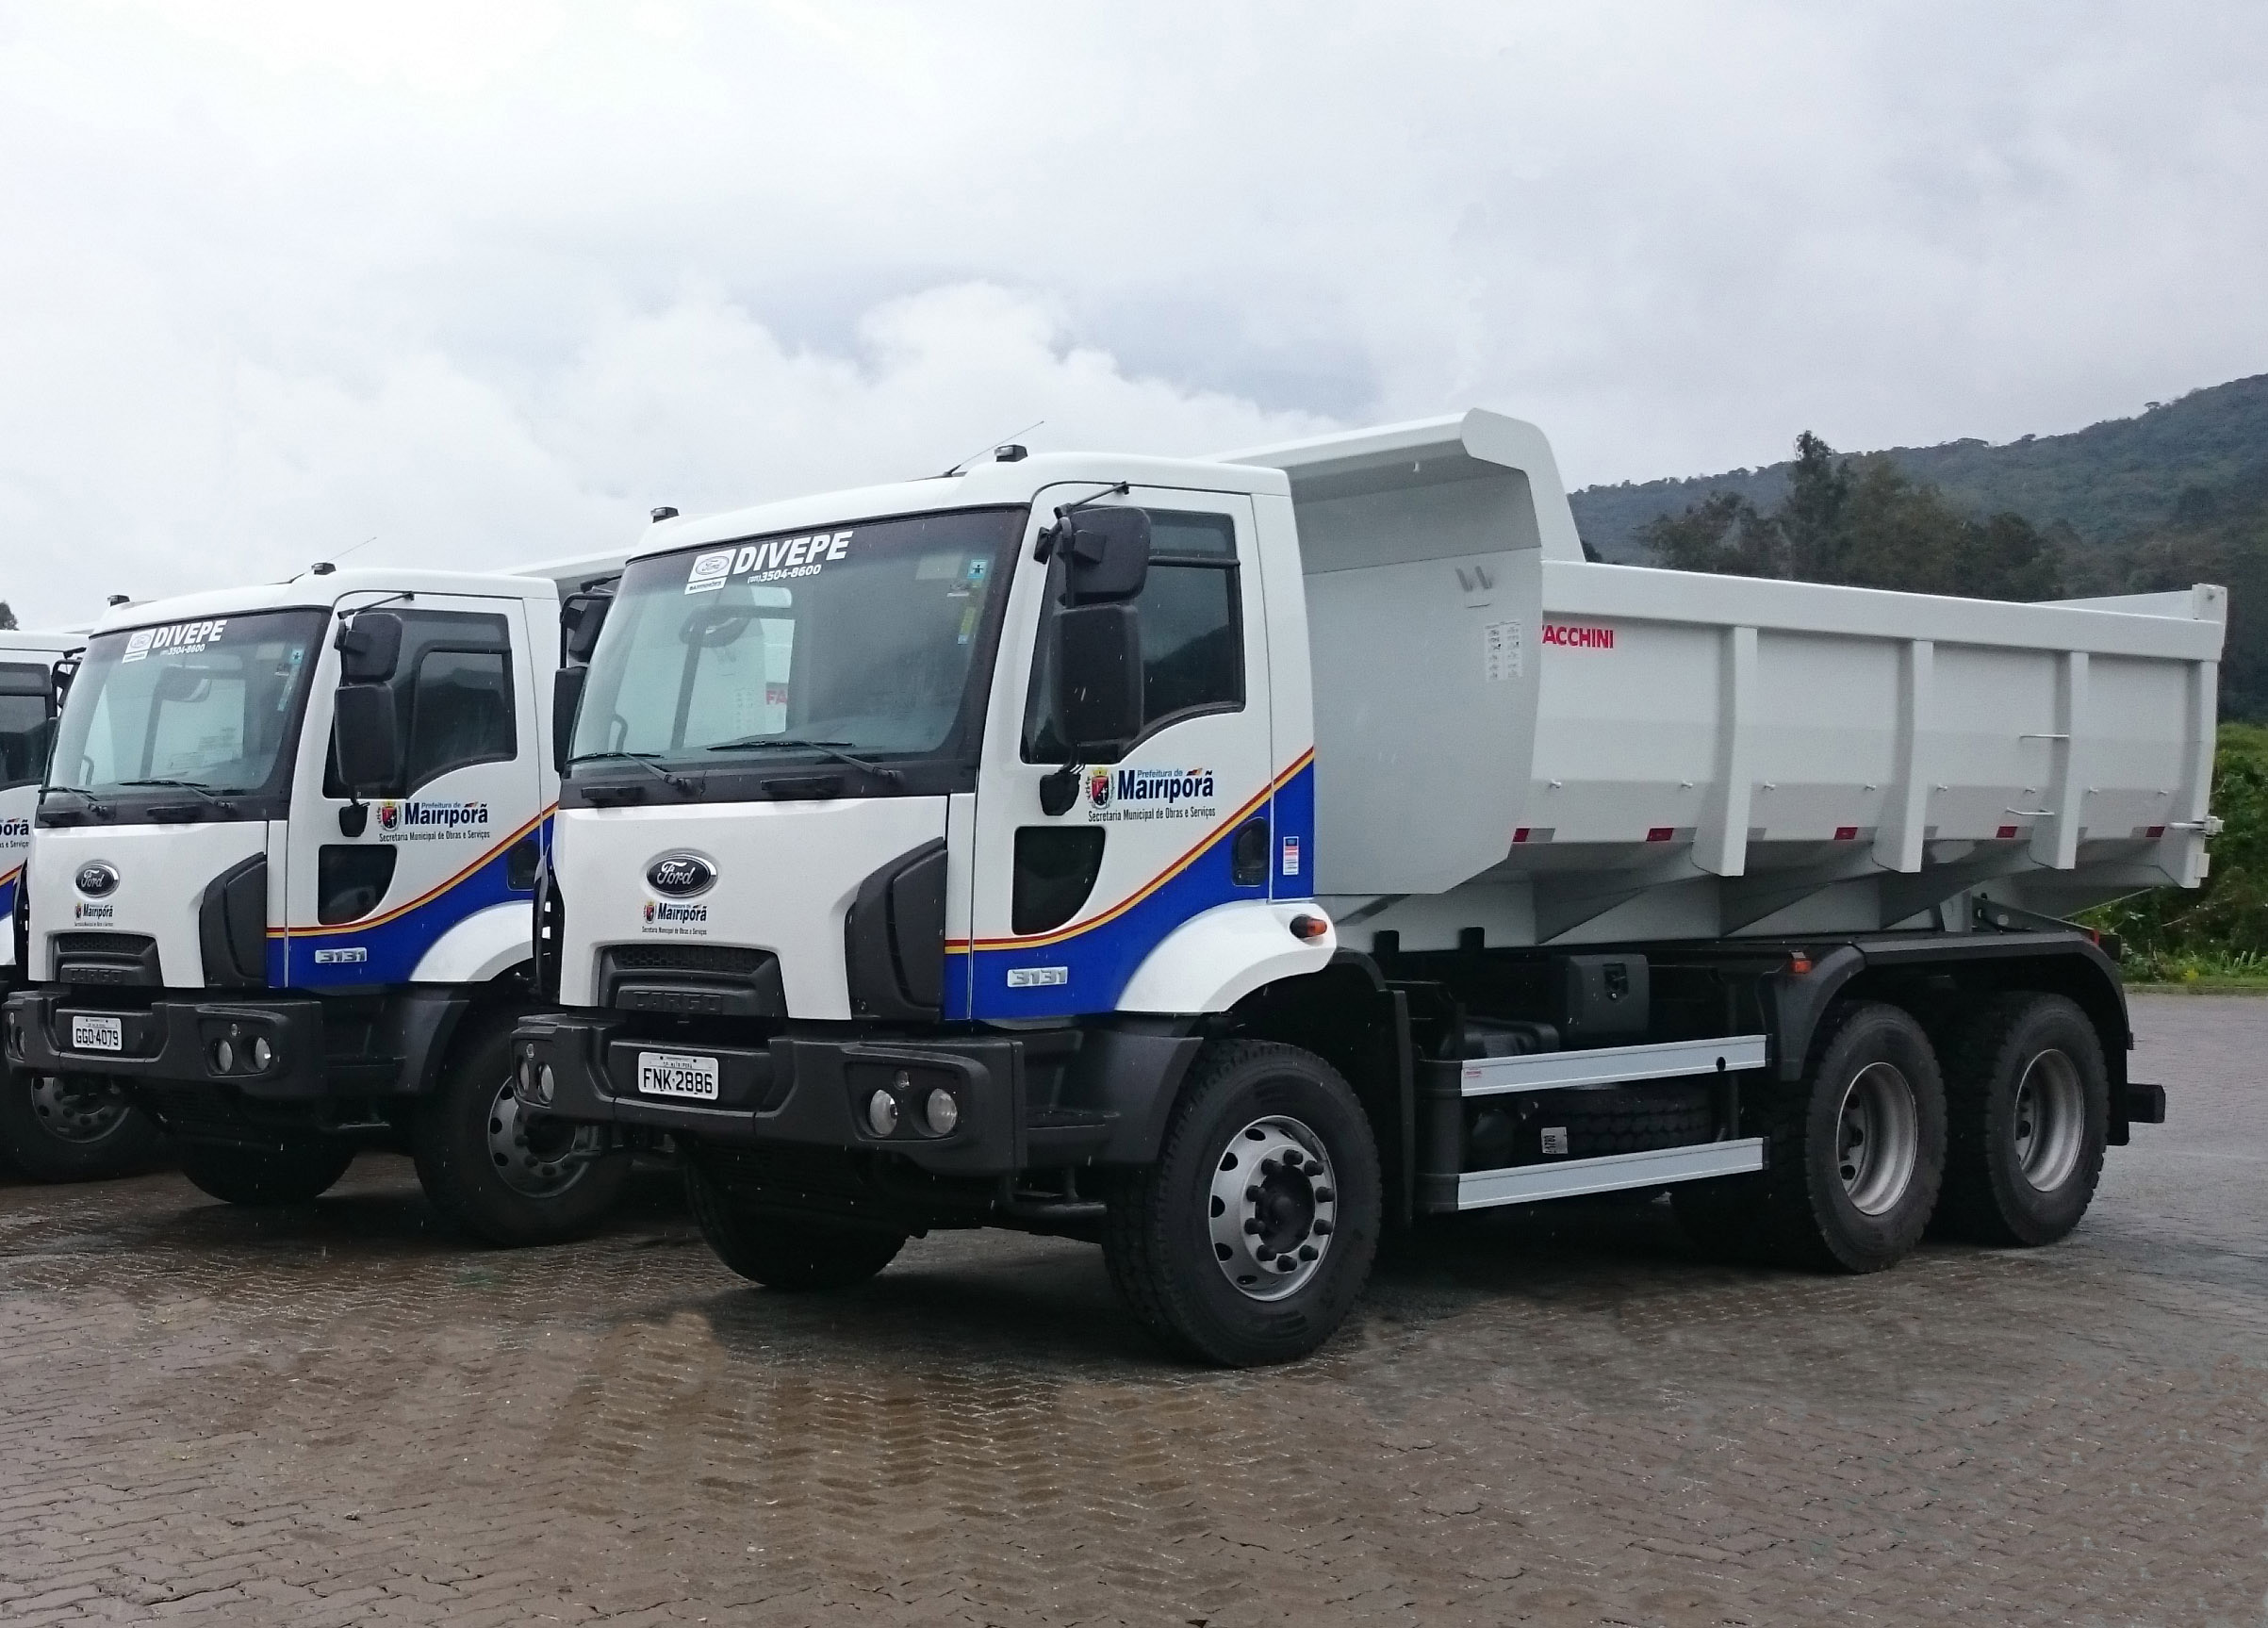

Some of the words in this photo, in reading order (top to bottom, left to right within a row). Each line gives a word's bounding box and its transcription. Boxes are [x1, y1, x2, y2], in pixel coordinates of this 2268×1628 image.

[732, 531, 853, 574] DIVEPE
[153, 619, 227, 649] DIVEPE
[1542, 625, 1614, 650] ACCHINI
[1137, 769, 1173, 778] Prefeitura
[1174, 768, 1183, 777] de
[1117, 770, 1213, 803] Mairiporã
[404, 802, 488, 828] Mairiporã
[1088, 810, 1122, 822] Secretaria
[1123, 808, 1154, 822] Municipal
[1156, 808, 1163, 819] de
[1165, 807, 1183, 818] Obras
[1184, 810, 1189, 818] e
[1190, 806, 1216, 819] Serviços
[379, 833, 408, 842] Secretaria
[409, 831, 436, 842] Municipal
[437, 830, 444, 840] de
[446, 830, 462, 839] Obras
[468, 830, 490, 840] Serviços
[81, 869, 105, 887] Ford
[657, 861, 696, 885] Ford
[657, 902, 707, 924] Mairiporã
[315, 947, 368, 963] 3131
[1007, 966, 1068, 988] 3131
